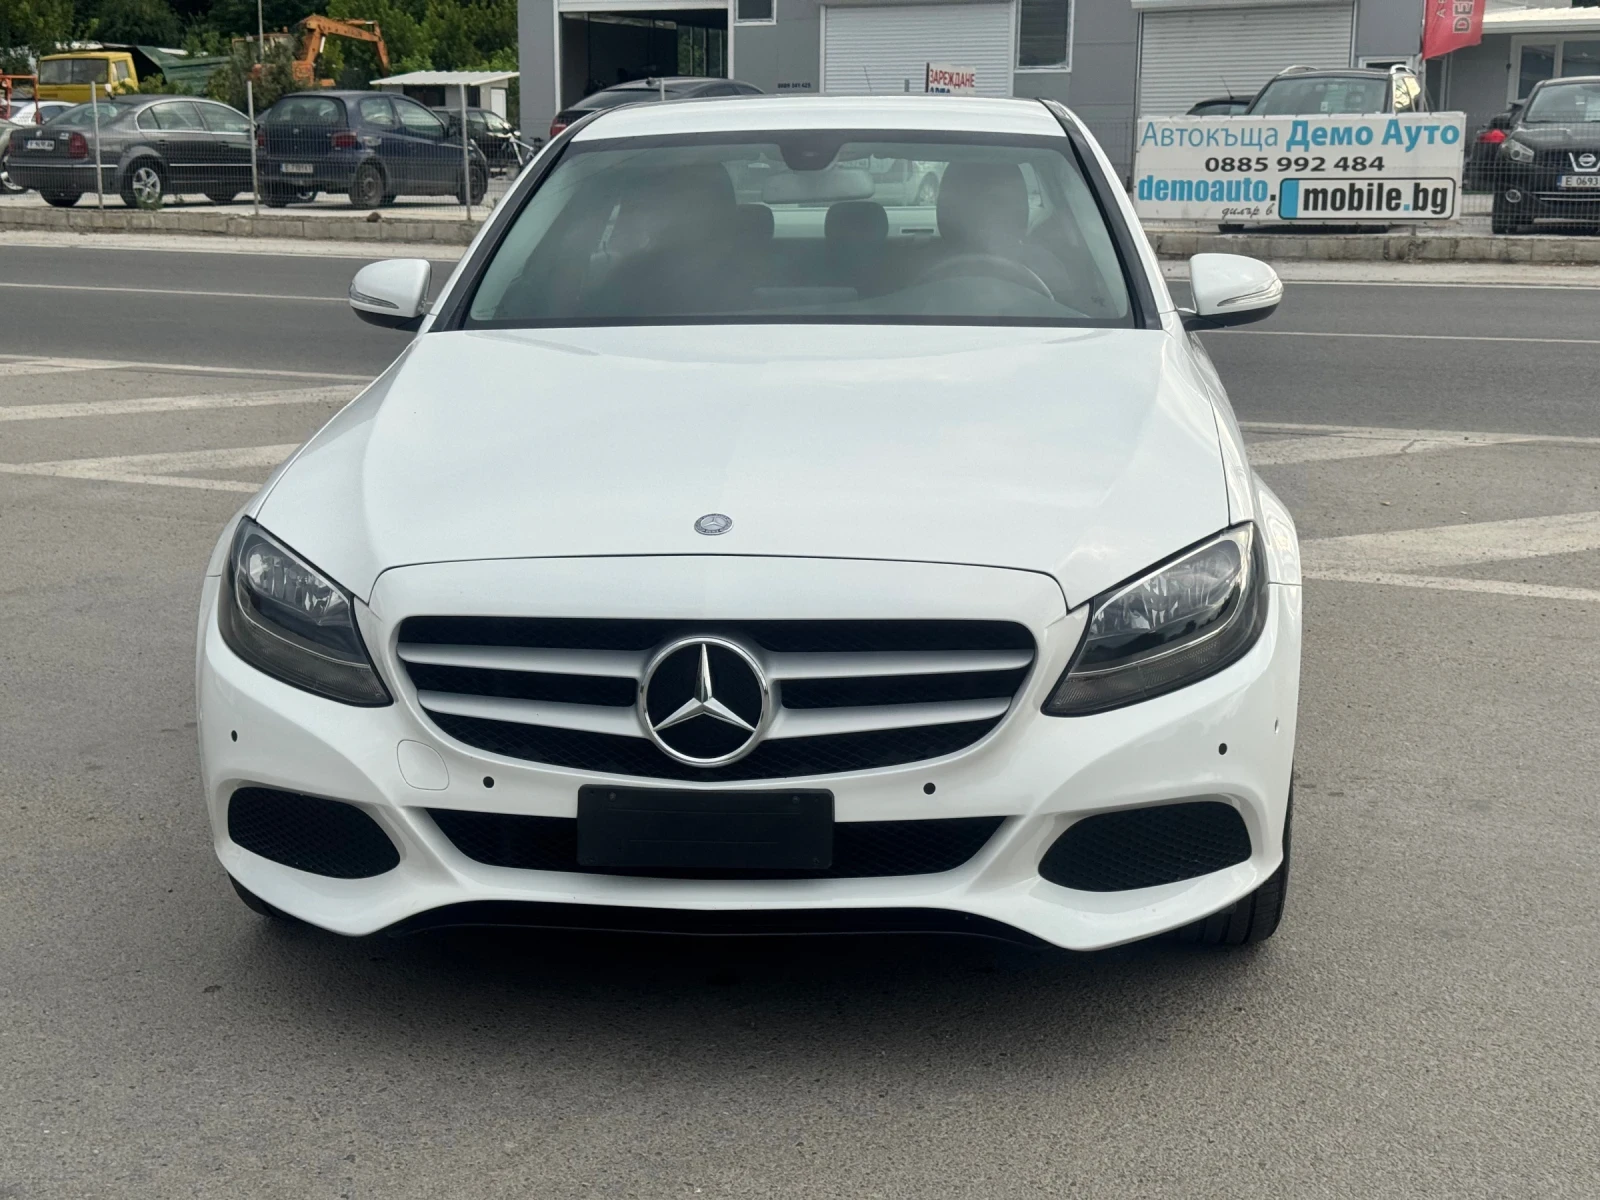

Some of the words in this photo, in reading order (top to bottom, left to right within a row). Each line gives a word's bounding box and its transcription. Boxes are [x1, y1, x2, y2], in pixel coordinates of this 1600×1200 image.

[1453, 0, 1475, 33] DE
[930, 69, 975, 89] ЗАРЕЖДАНЕ
[1141, 121, 1278, 152] Автокъща
[1285, 119, 1374, 152] Демо
[1381, 118, 1460, 153] Ауто
[1205, 157, 1268, 172] 0885
[1276, 156, 1326, 172] 992
[1333, 156, 1385, 172] 484
[1565, 177, 1572, 186] E
[1576, 177, 1599, 186] 0693
[1303, 182, 1448, 215] mobile.bg
